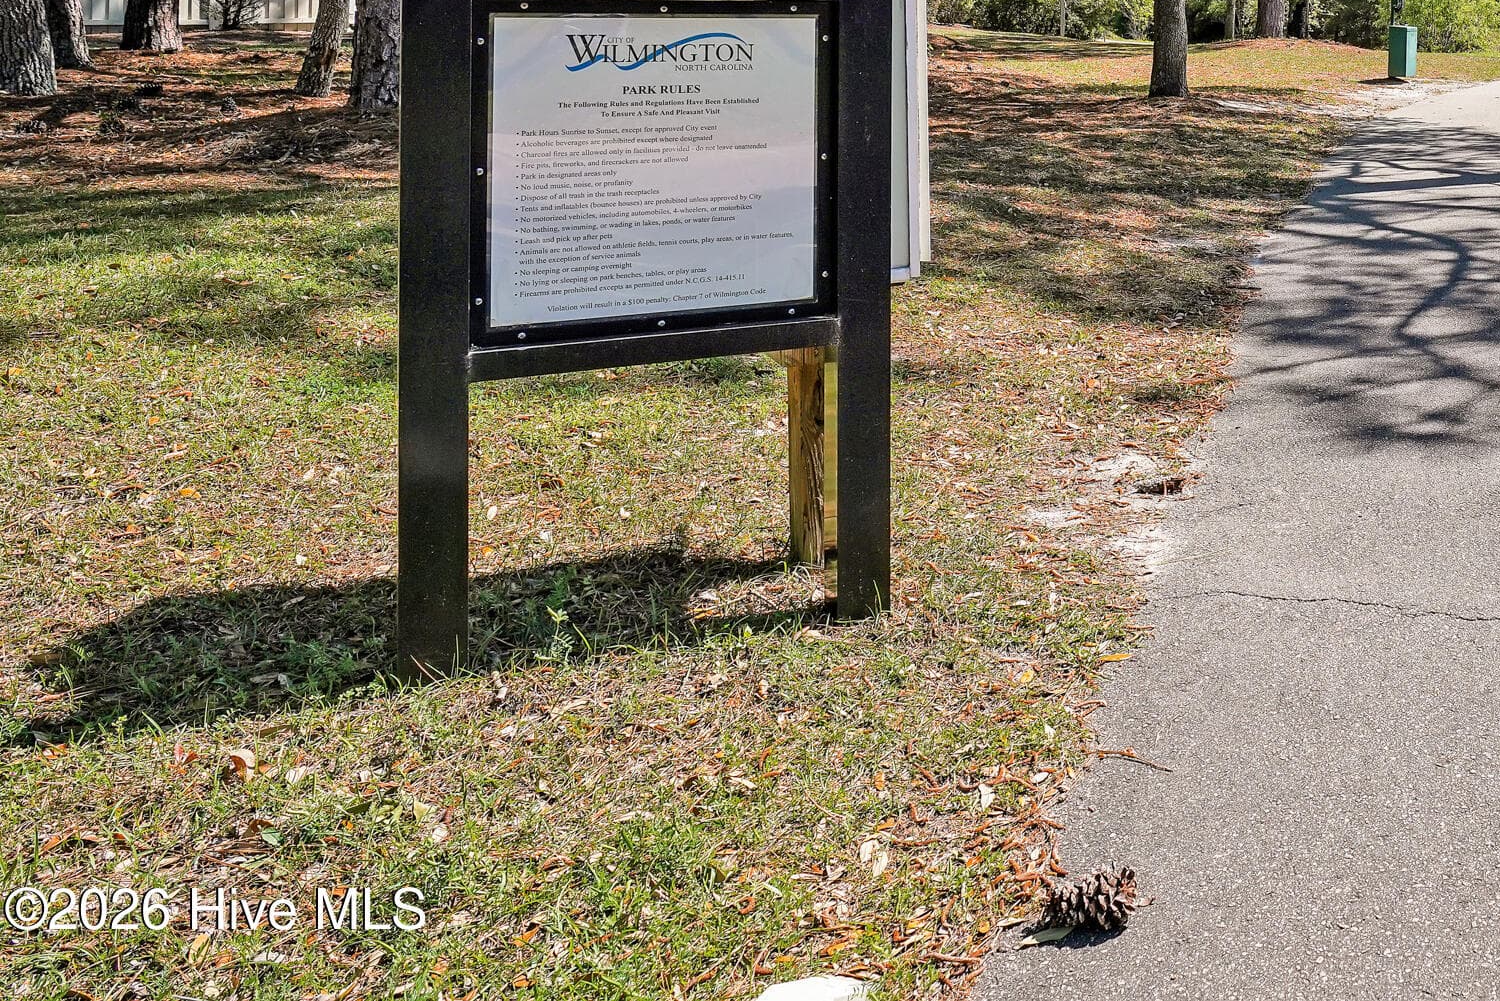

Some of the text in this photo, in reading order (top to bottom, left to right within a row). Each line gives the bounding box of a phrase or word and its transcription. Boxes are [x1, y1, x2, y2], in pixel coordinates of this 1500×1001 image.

[566, 34, 754, 63] WILMINGTON
[710, 63, 754, 71] CAROLINA
[622, 85, 701, 95] PARK RULES
[573, 100, 608, 110] Following
[630, 99, 643, 107] and
[645, 99, 684, 108] Regulations
[722, 97, 759, 105] Established
[660, 108, 674, 116] And
[540, 128, 559, 136] Hours
[561, 127, 586, 135] Sunrise
[621, 126, 642, 135] except
[654, 124, 684, 134] approved
[685, 124, 698, 133] City
[521, 139, 553, 147] Alcoholic
[556, 139, 589, 148] beverages
[602, 136, 635, 147] prohibited
[637, 136, 658, 145] except
[680, 133, 713, 143] designated
[534, 182, 548, 190] loud
[604, 179, 633, 189] profanity
[521, 194, 548, 203] Dispose
[550, 192, 558, 200] of
[569, 191, 584, 199] trash
[595, 190, 604, 198] the
[607, 189, 623, 197] trash
[624, 188, 659, 198] receptacles
[541, 203, 552, 211] and
[555, 202, 588, 210] inflatables
[590, 201, 616, 210] (bounce
[618, 198, 642, 207] houses)
[656, 196, 687, 207] prohibited
[710, 193, 738, 204] approved
[740, 193, 748, 202] by
[749, 192, 762, 201] City
[533, 213, 566, 222] motorized
[568, 212, 597, 220] vehicles,
[599, 210, 629, 219] including
[718, 203, 752, 211] motorbikes
[609, 220, 632, 229] wading
[520, 236, 540, 244] Leash
[542, 235, 554, 243] and
[556, 234, 571, 244] pick
[583, 233, 598, 241] after
[600, 233, 613, 242] pets
[520, 247, 548, 256] Animals
[575, 243, 600, 252] allowed
[612, 241, 636, 249] athletic
[658, 238, 677, 246] tennis
[701, 236, 714, 245] play
[519, 256, 534, 264] with
[548, 254, 580, 264] exception
[591, 251, 614, 260] service
[616, 249, 641, 258] animals
[520, 268, 530, 276] No
[532, 266, 560, 276] sleeping
[570, 264, 599, 273] camping
[601, 261, 632, 271] overnight
[532, 278, 550, 287] lying
[560, 275, 588, 285] sleeping
[600, 272, 614, 283] park
[645, 269, 665, 277] tables,
[676, 267, 689, 277] play
[564, 284, 597, 296] prohibited
[634, 279, 664, 290] permitted
[666, 278, 683, 286] under
[547, 303, 578, 312] Violation
[580, 301, 592, 309] will
[594, 300, 612, 308] result
[628, 297, 644, 305] $100
[673, 294, 697, 303] Chapter
[713, 290, 748, 299] Wilmington
[750, 287, 766, 295] Code
